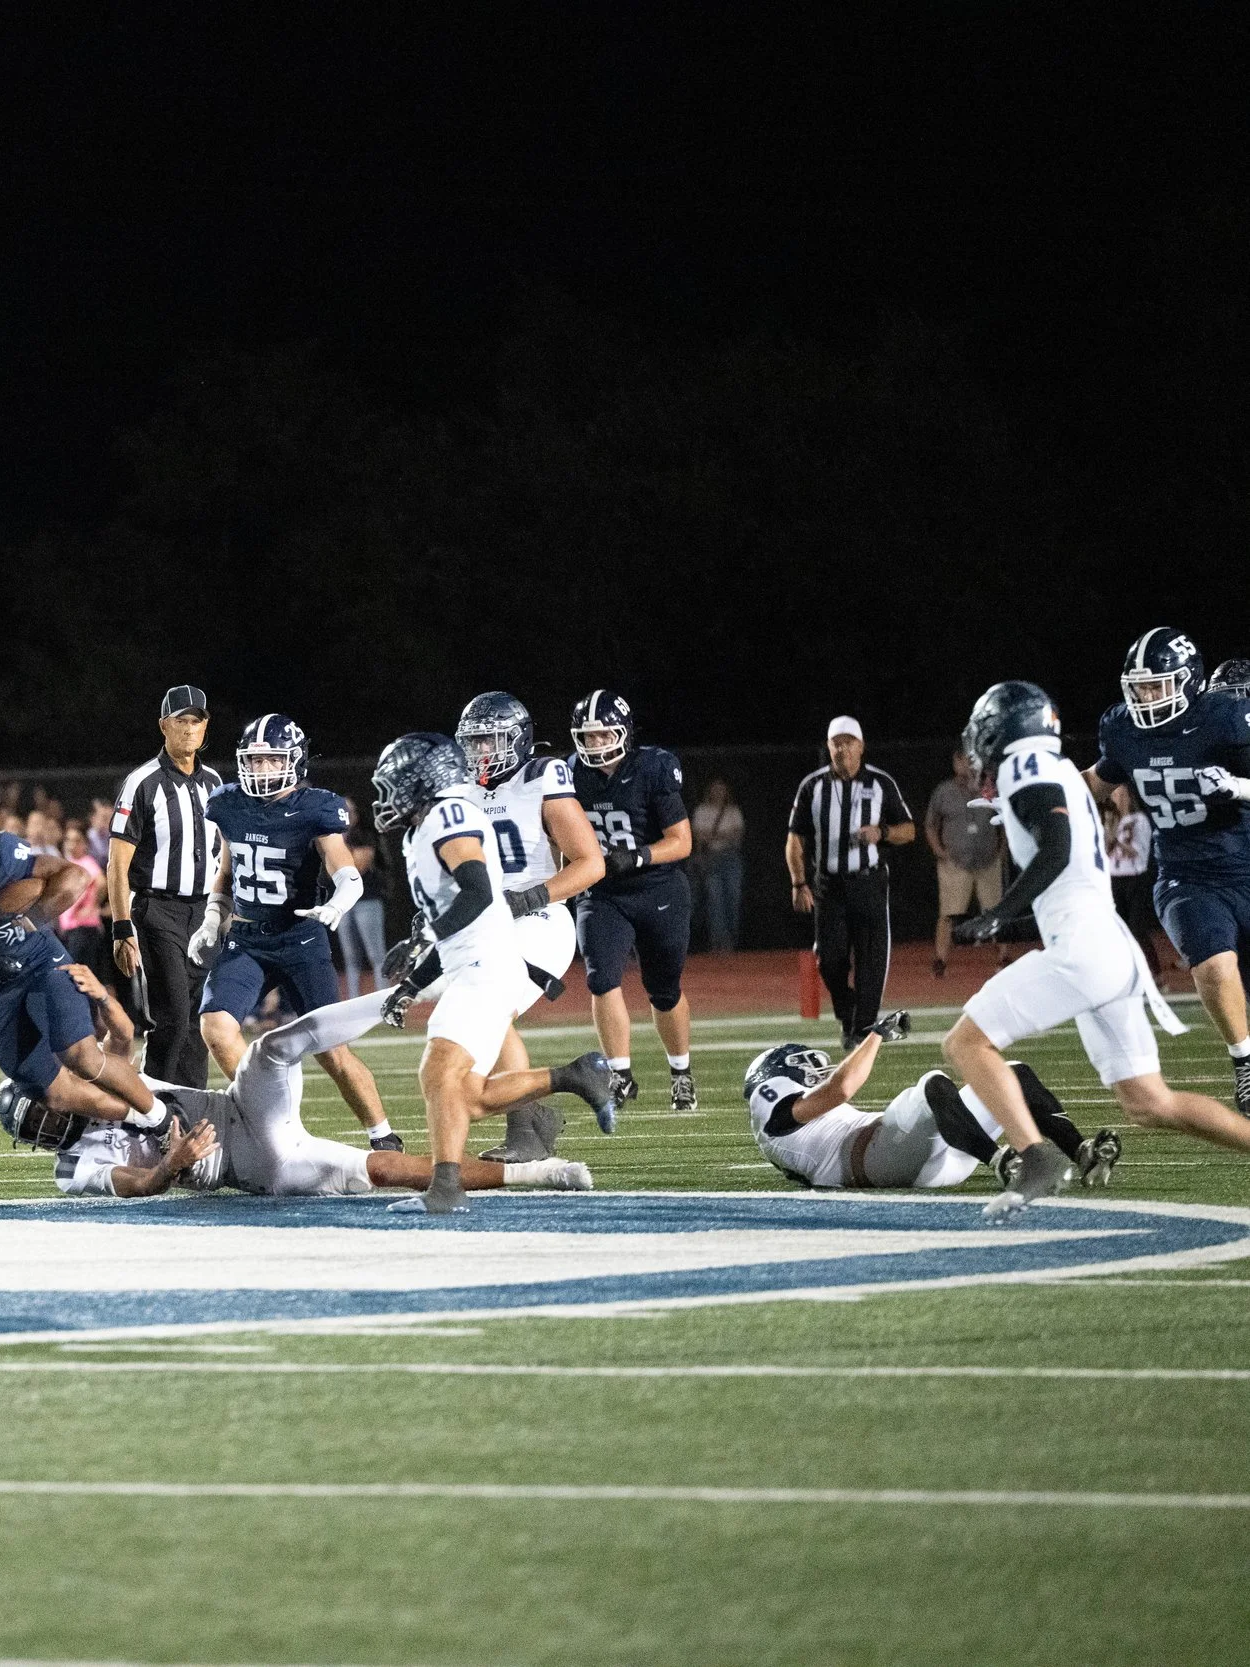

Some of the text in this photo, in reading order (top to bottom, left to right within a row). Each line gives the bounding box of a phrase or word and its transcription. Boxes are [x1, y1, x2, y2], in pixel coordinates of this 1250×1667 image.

[1168, 634, 1197, 662] 55
[1012, 753, 1039, 782] 14
[483, 805, 507, 815] MPION
[1132, 767, 1207, 829] 55
[439, 803, 465, 830] 10
[244, 832, 269, 844] RANGERS
[492, 818, 528, 874] 0
[230, 841, 288, 905] 25
[758, 1084, 779, 1103] 6
